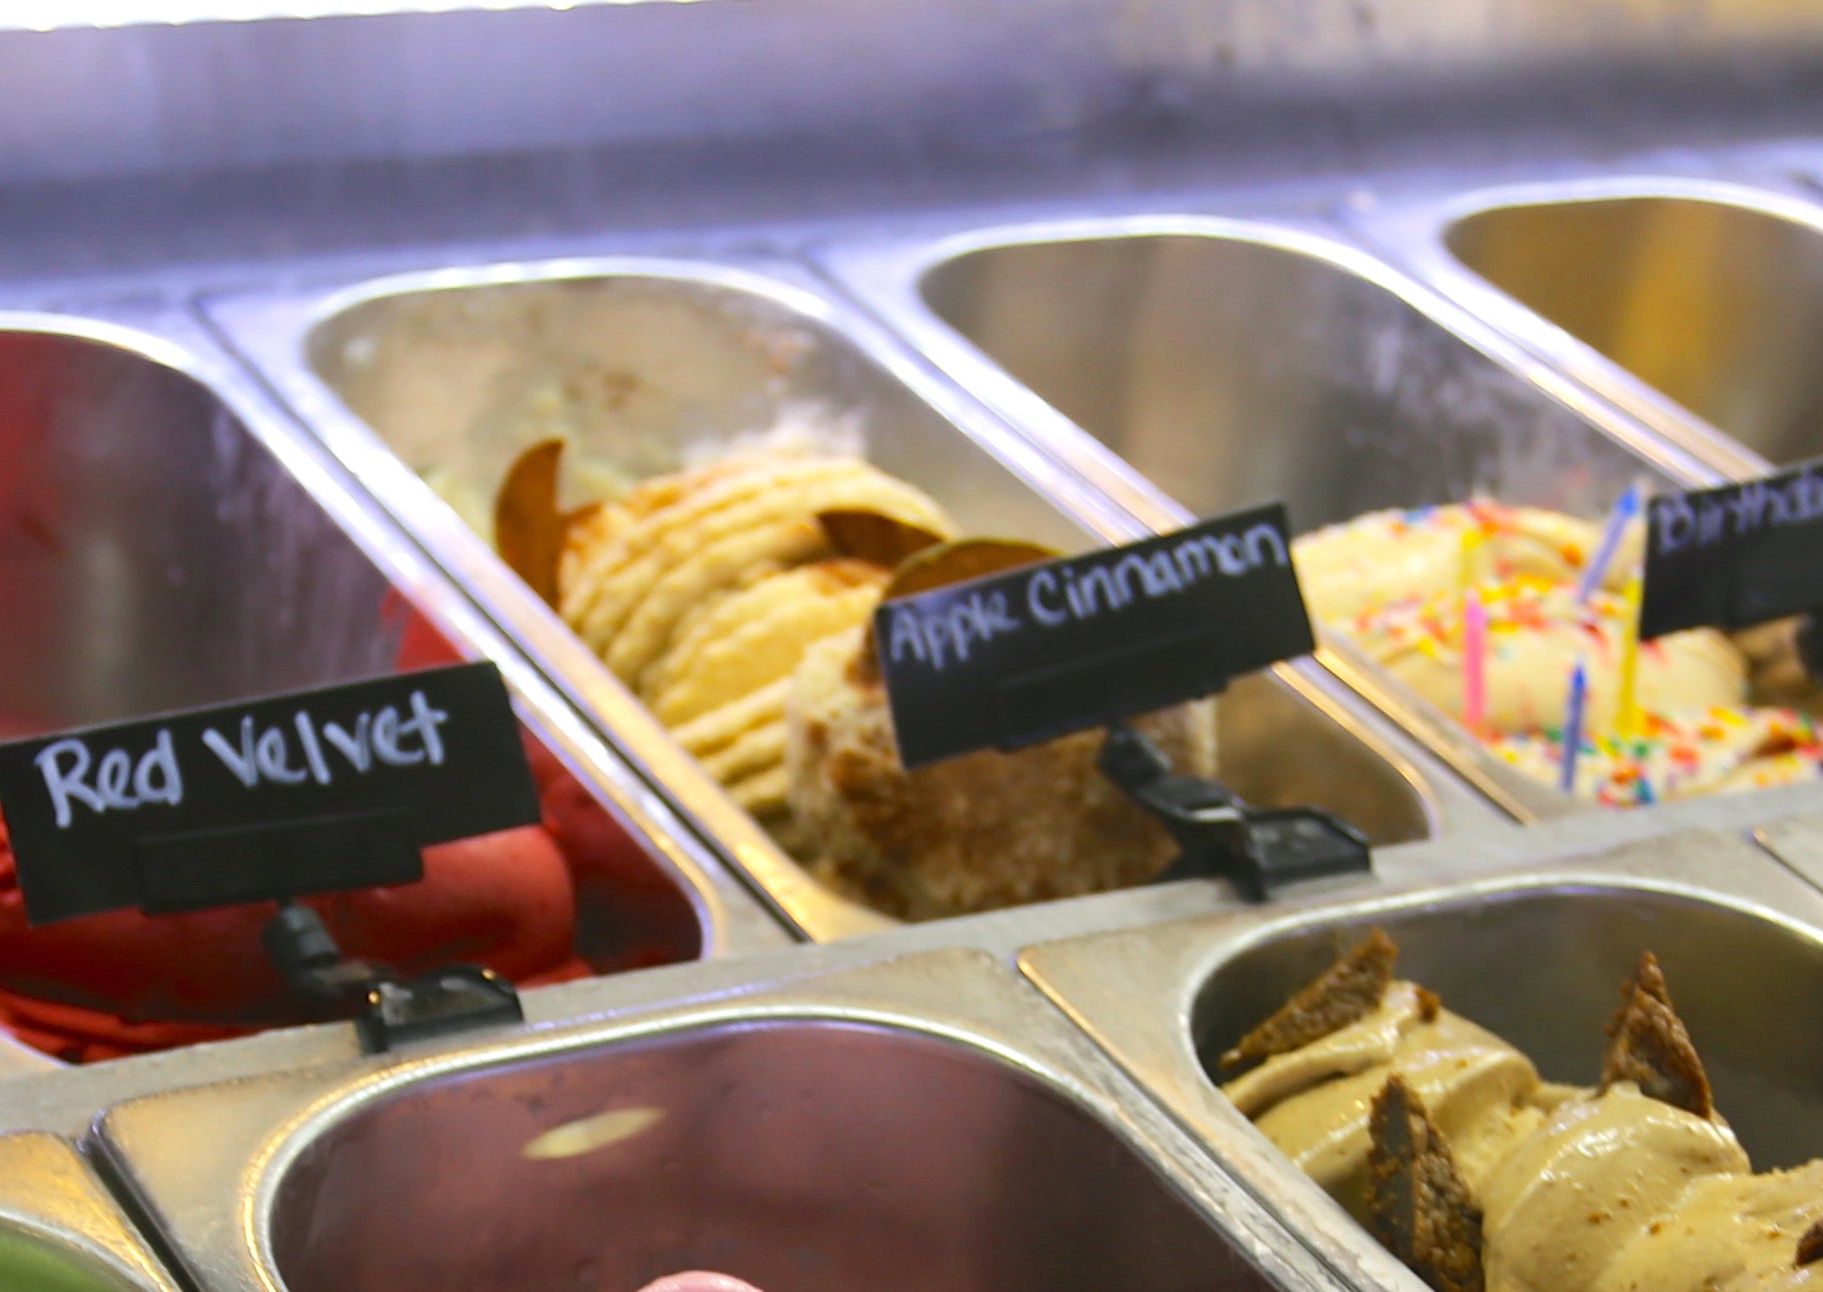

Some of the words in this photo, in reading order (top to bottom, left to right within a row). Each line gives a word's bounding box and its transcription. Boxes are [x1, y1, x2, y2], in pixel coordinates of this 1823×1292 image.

[890, 592, 1022, 670] Apple
[1029, 523, 1289, 624] Cinnamon
[34, 729, 182, 828] Red
[203, 691, 447, 788] Velvet
